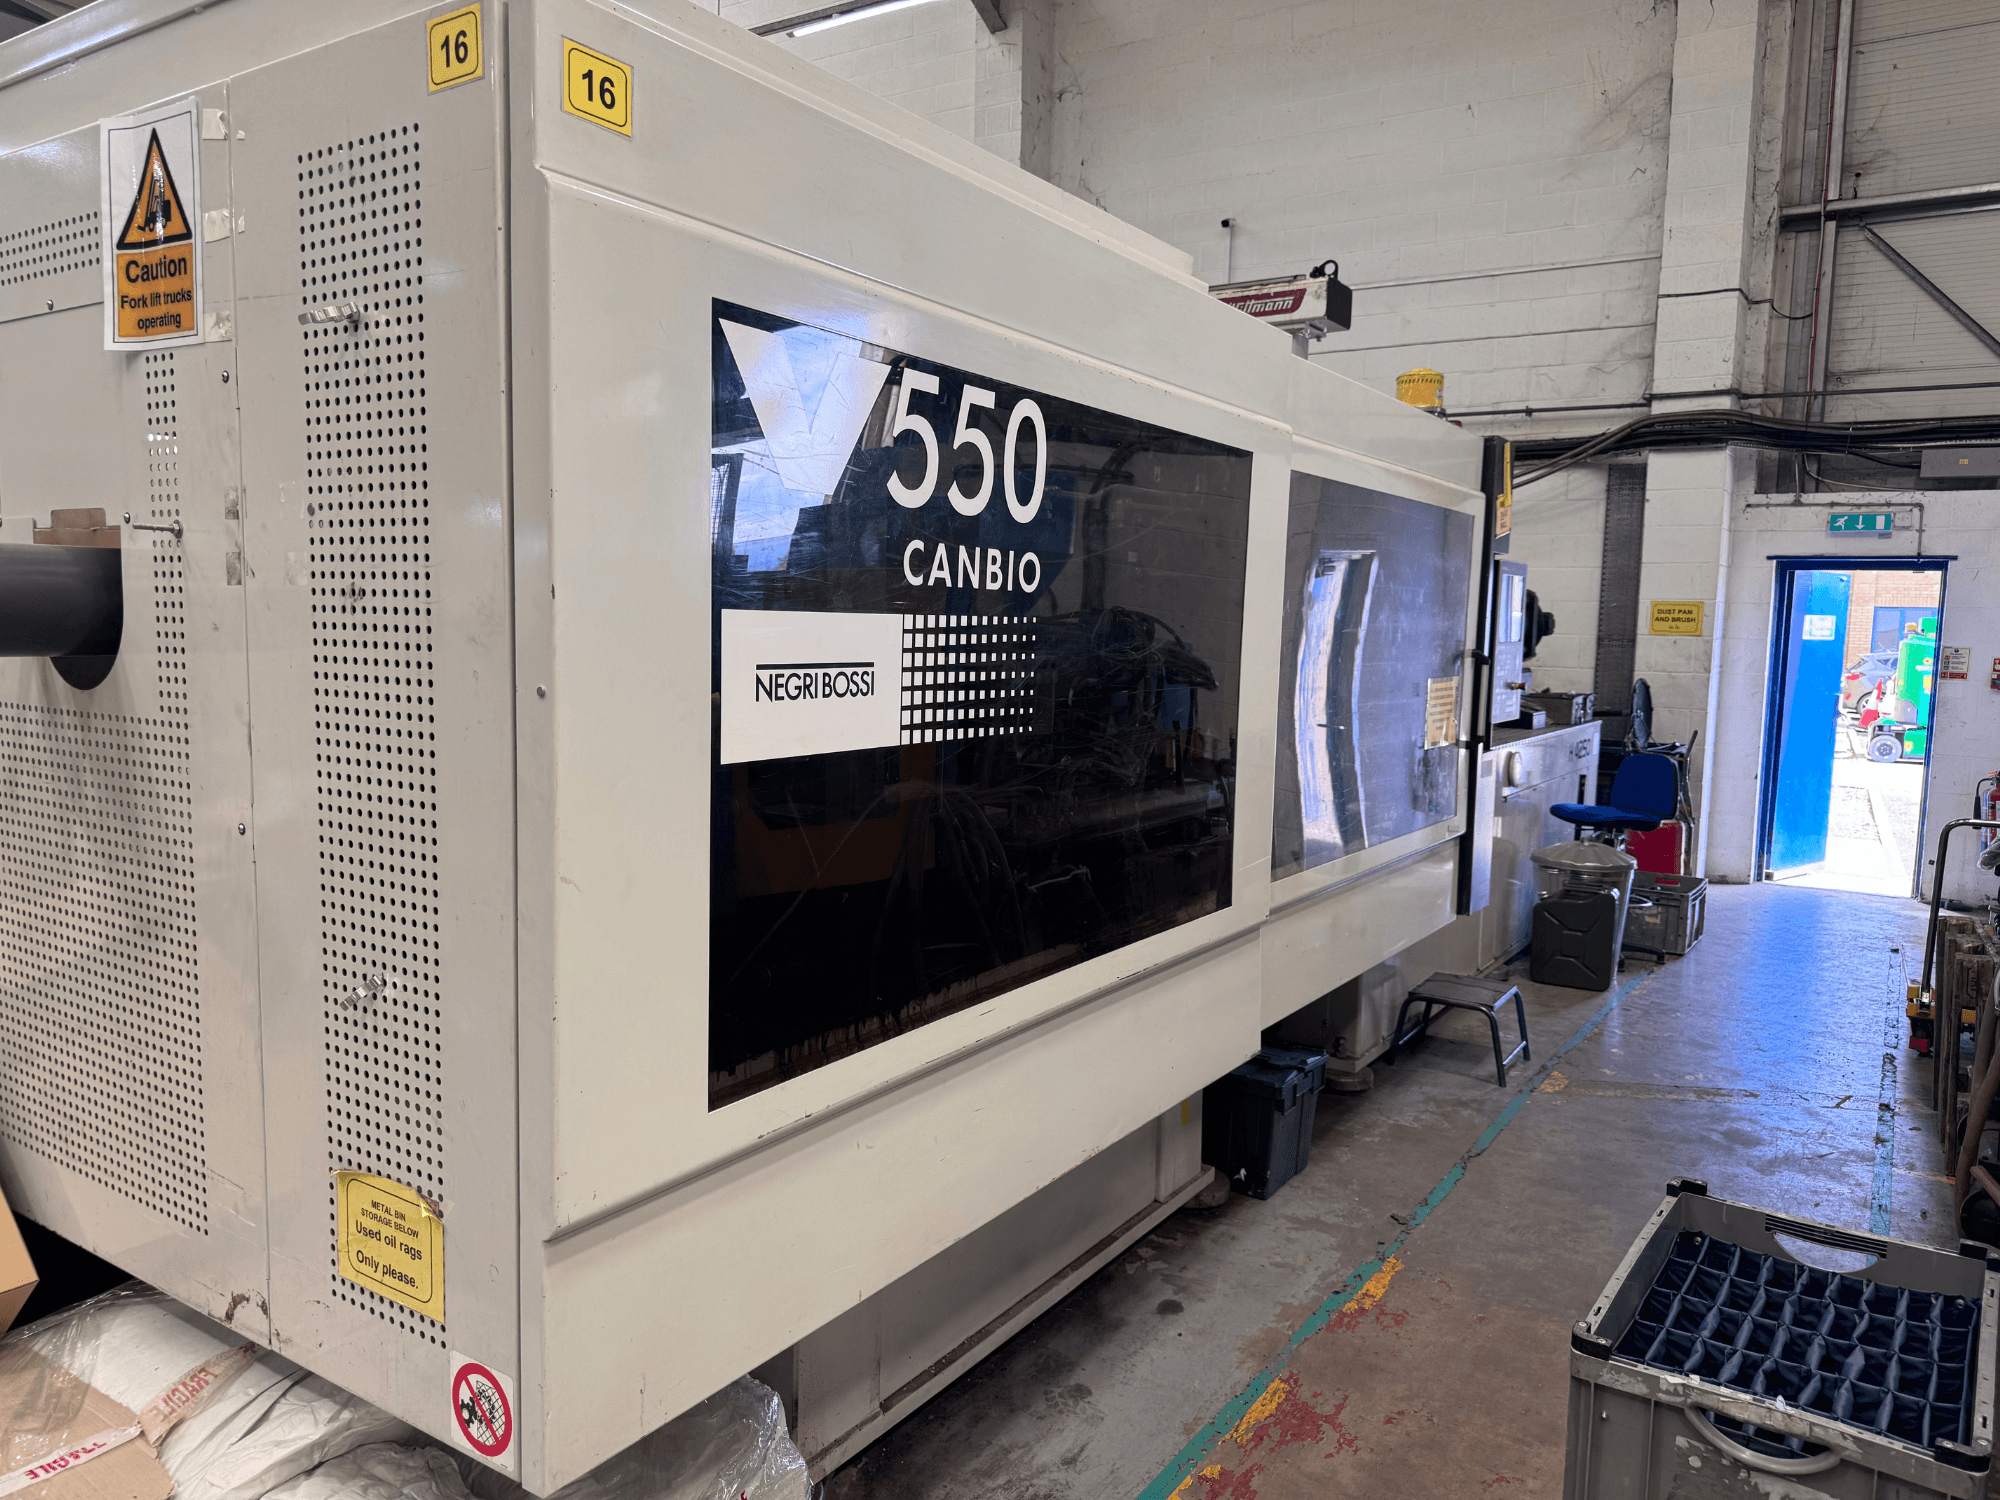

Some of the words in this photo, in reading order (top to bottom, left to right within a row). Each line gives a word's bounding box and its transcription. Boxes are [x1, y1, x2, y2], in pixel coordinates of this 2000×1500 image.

[441, 30, 468, 68] 16
[582, 69, 616, 109] 16
[125, 254, 187, 283] Caution
[120, 294, 148, 309] Fork
[150, 291, 162, 307] lift
[163, 288, 192, 305] trucks
[137, 312, 182, 333] operating
[903, 539, 1041, 593] CANBIO
[755, 672, 819, 703] NEGRI
[822, 670, 875, 699] BOSSI
[360, 1207, 393, 1229] STORAGE
[393, 1221, 420, 1239] BELOW
[371, 1199, 393, 1217] METAL
[394, 1209, 406, 1222] BIN
[355, 1219, 382, 1243] Used
[384, 1234, 397, 1249] oil
[399, 1241, 423, 1261] rags
[356, 1249, 380, 1274] Only
[382, 1263, 419, 1289] please.
